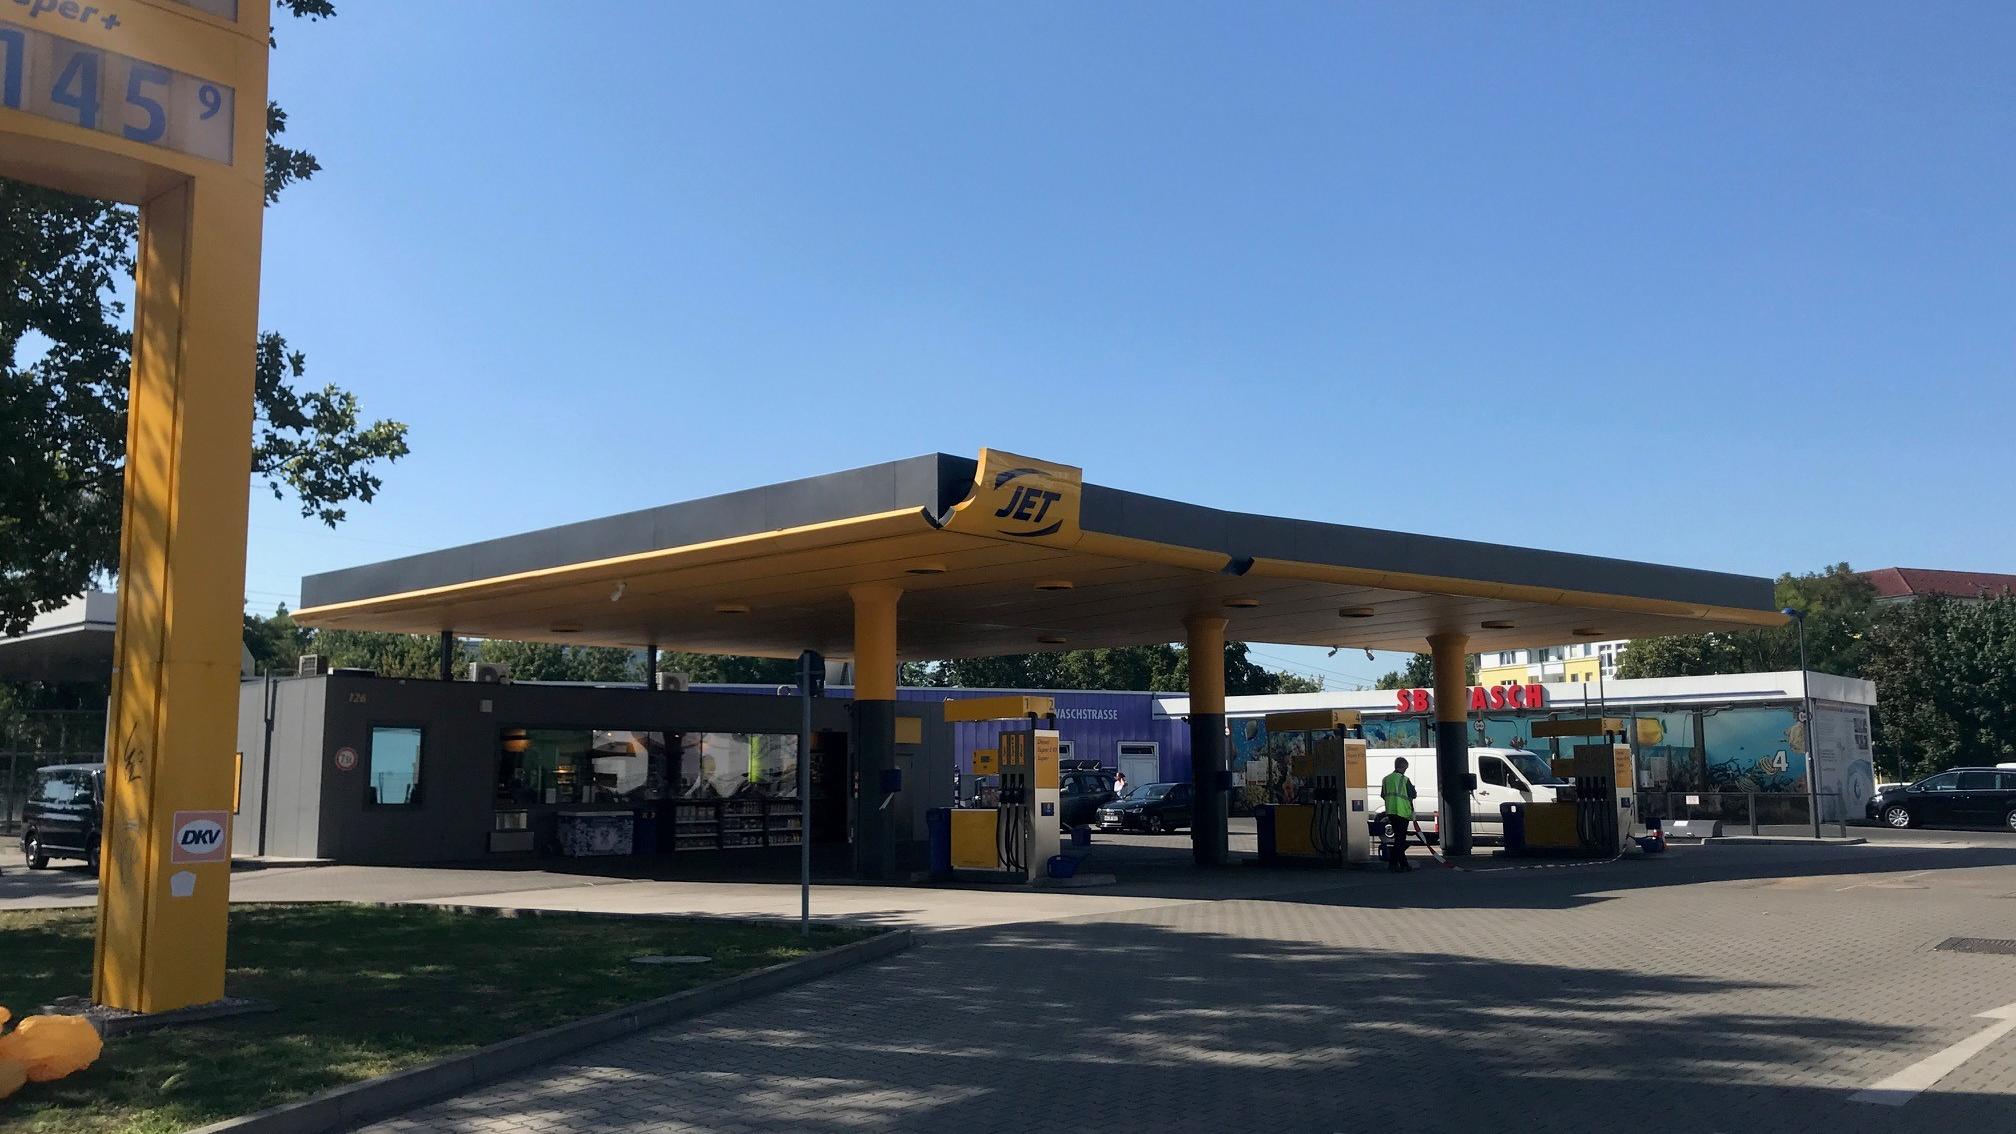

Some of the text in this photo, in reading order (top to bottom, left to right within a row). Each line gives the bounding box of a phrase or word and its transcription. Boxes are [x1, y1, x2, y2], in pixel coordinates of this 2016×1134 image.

[14, 0, 121, 30] per+
[995, 485, 1062, 523] JET
[1396, 684, 1543, 713] SB ASCH
[1772, 750, 1789, 772] 4
[181, 829, 221, 845] DKV
